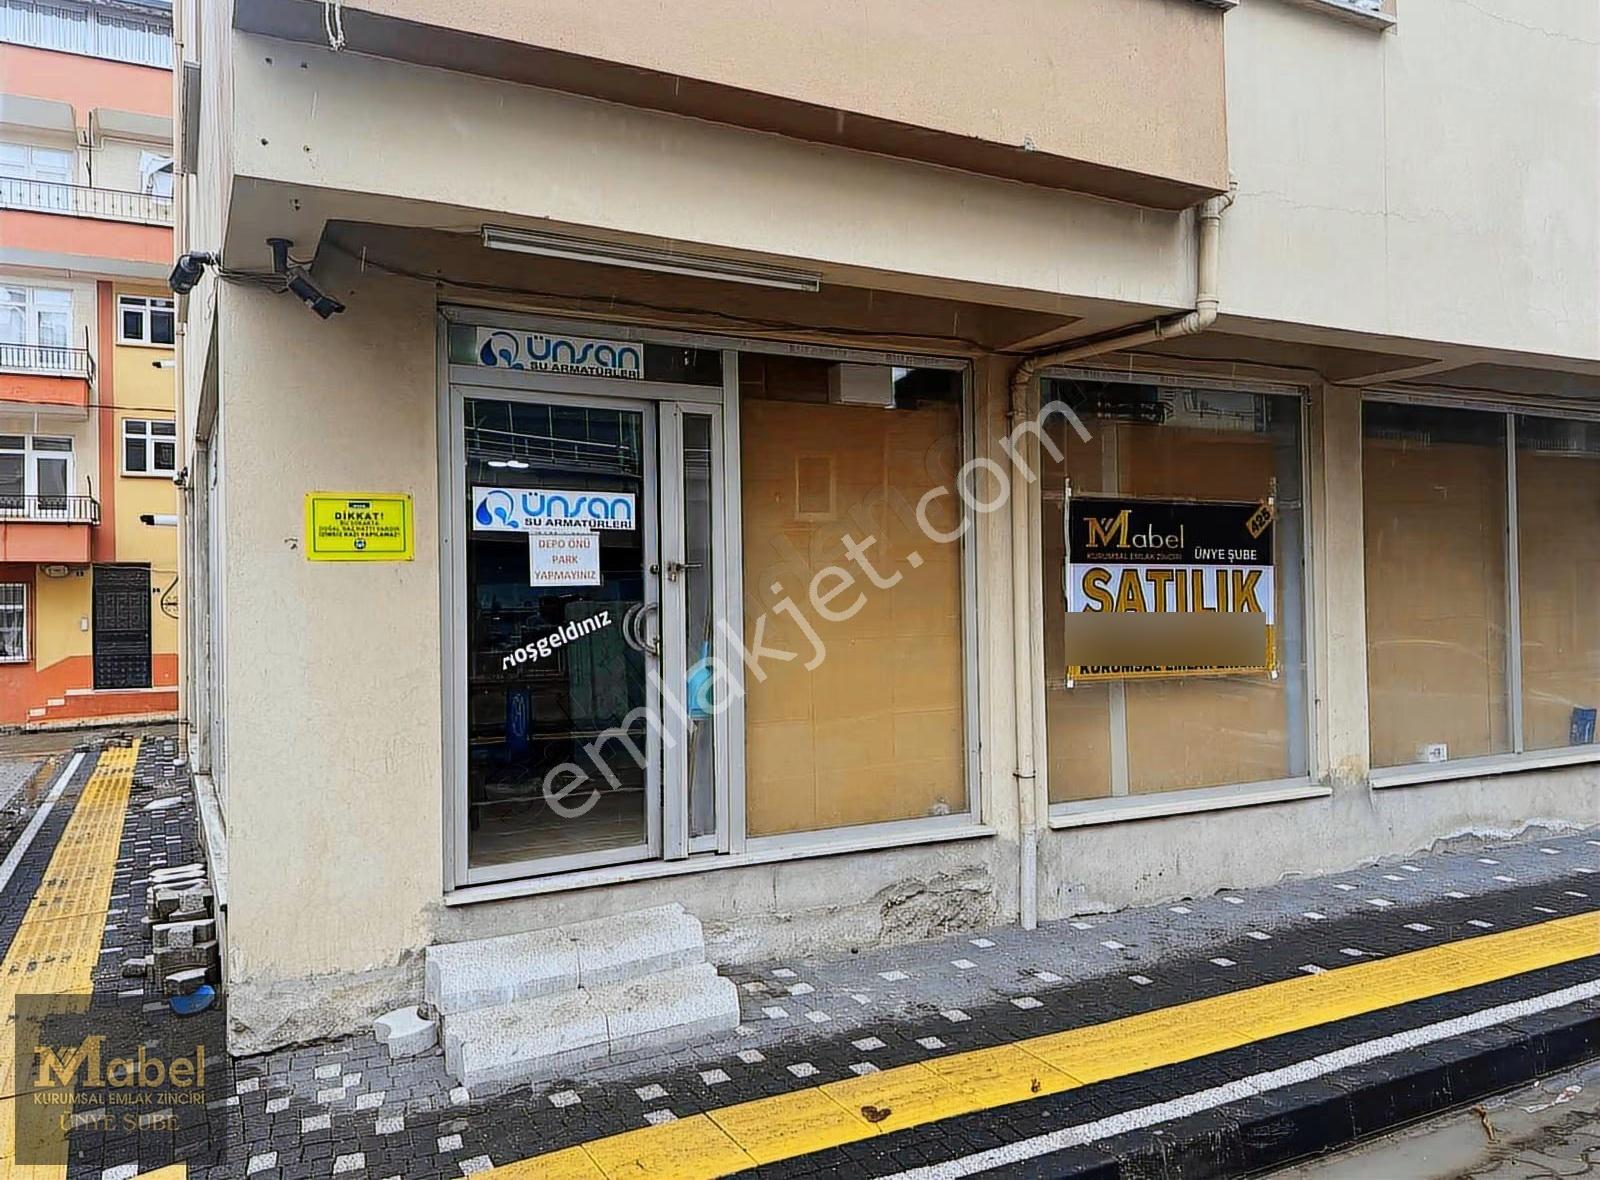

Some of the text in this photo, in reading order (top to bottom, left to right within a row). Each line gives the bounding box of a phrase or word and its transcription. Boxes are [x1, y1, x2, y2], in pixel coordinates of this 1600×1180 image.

[530, 361, 548, 371] SU
[525, 518, 543, 526] SU
[1083, 509, 1185, 549] Mabel
[538, 539, 566, 549] DEPO
[552, 554, 578, 565] PARK
[1194, 546, 1257, 563] ÜNYE ŞUBE
[534, 570, 597, 580] YAPMAYINIZ
[1081, 567, 1263, 612] SATILIK
